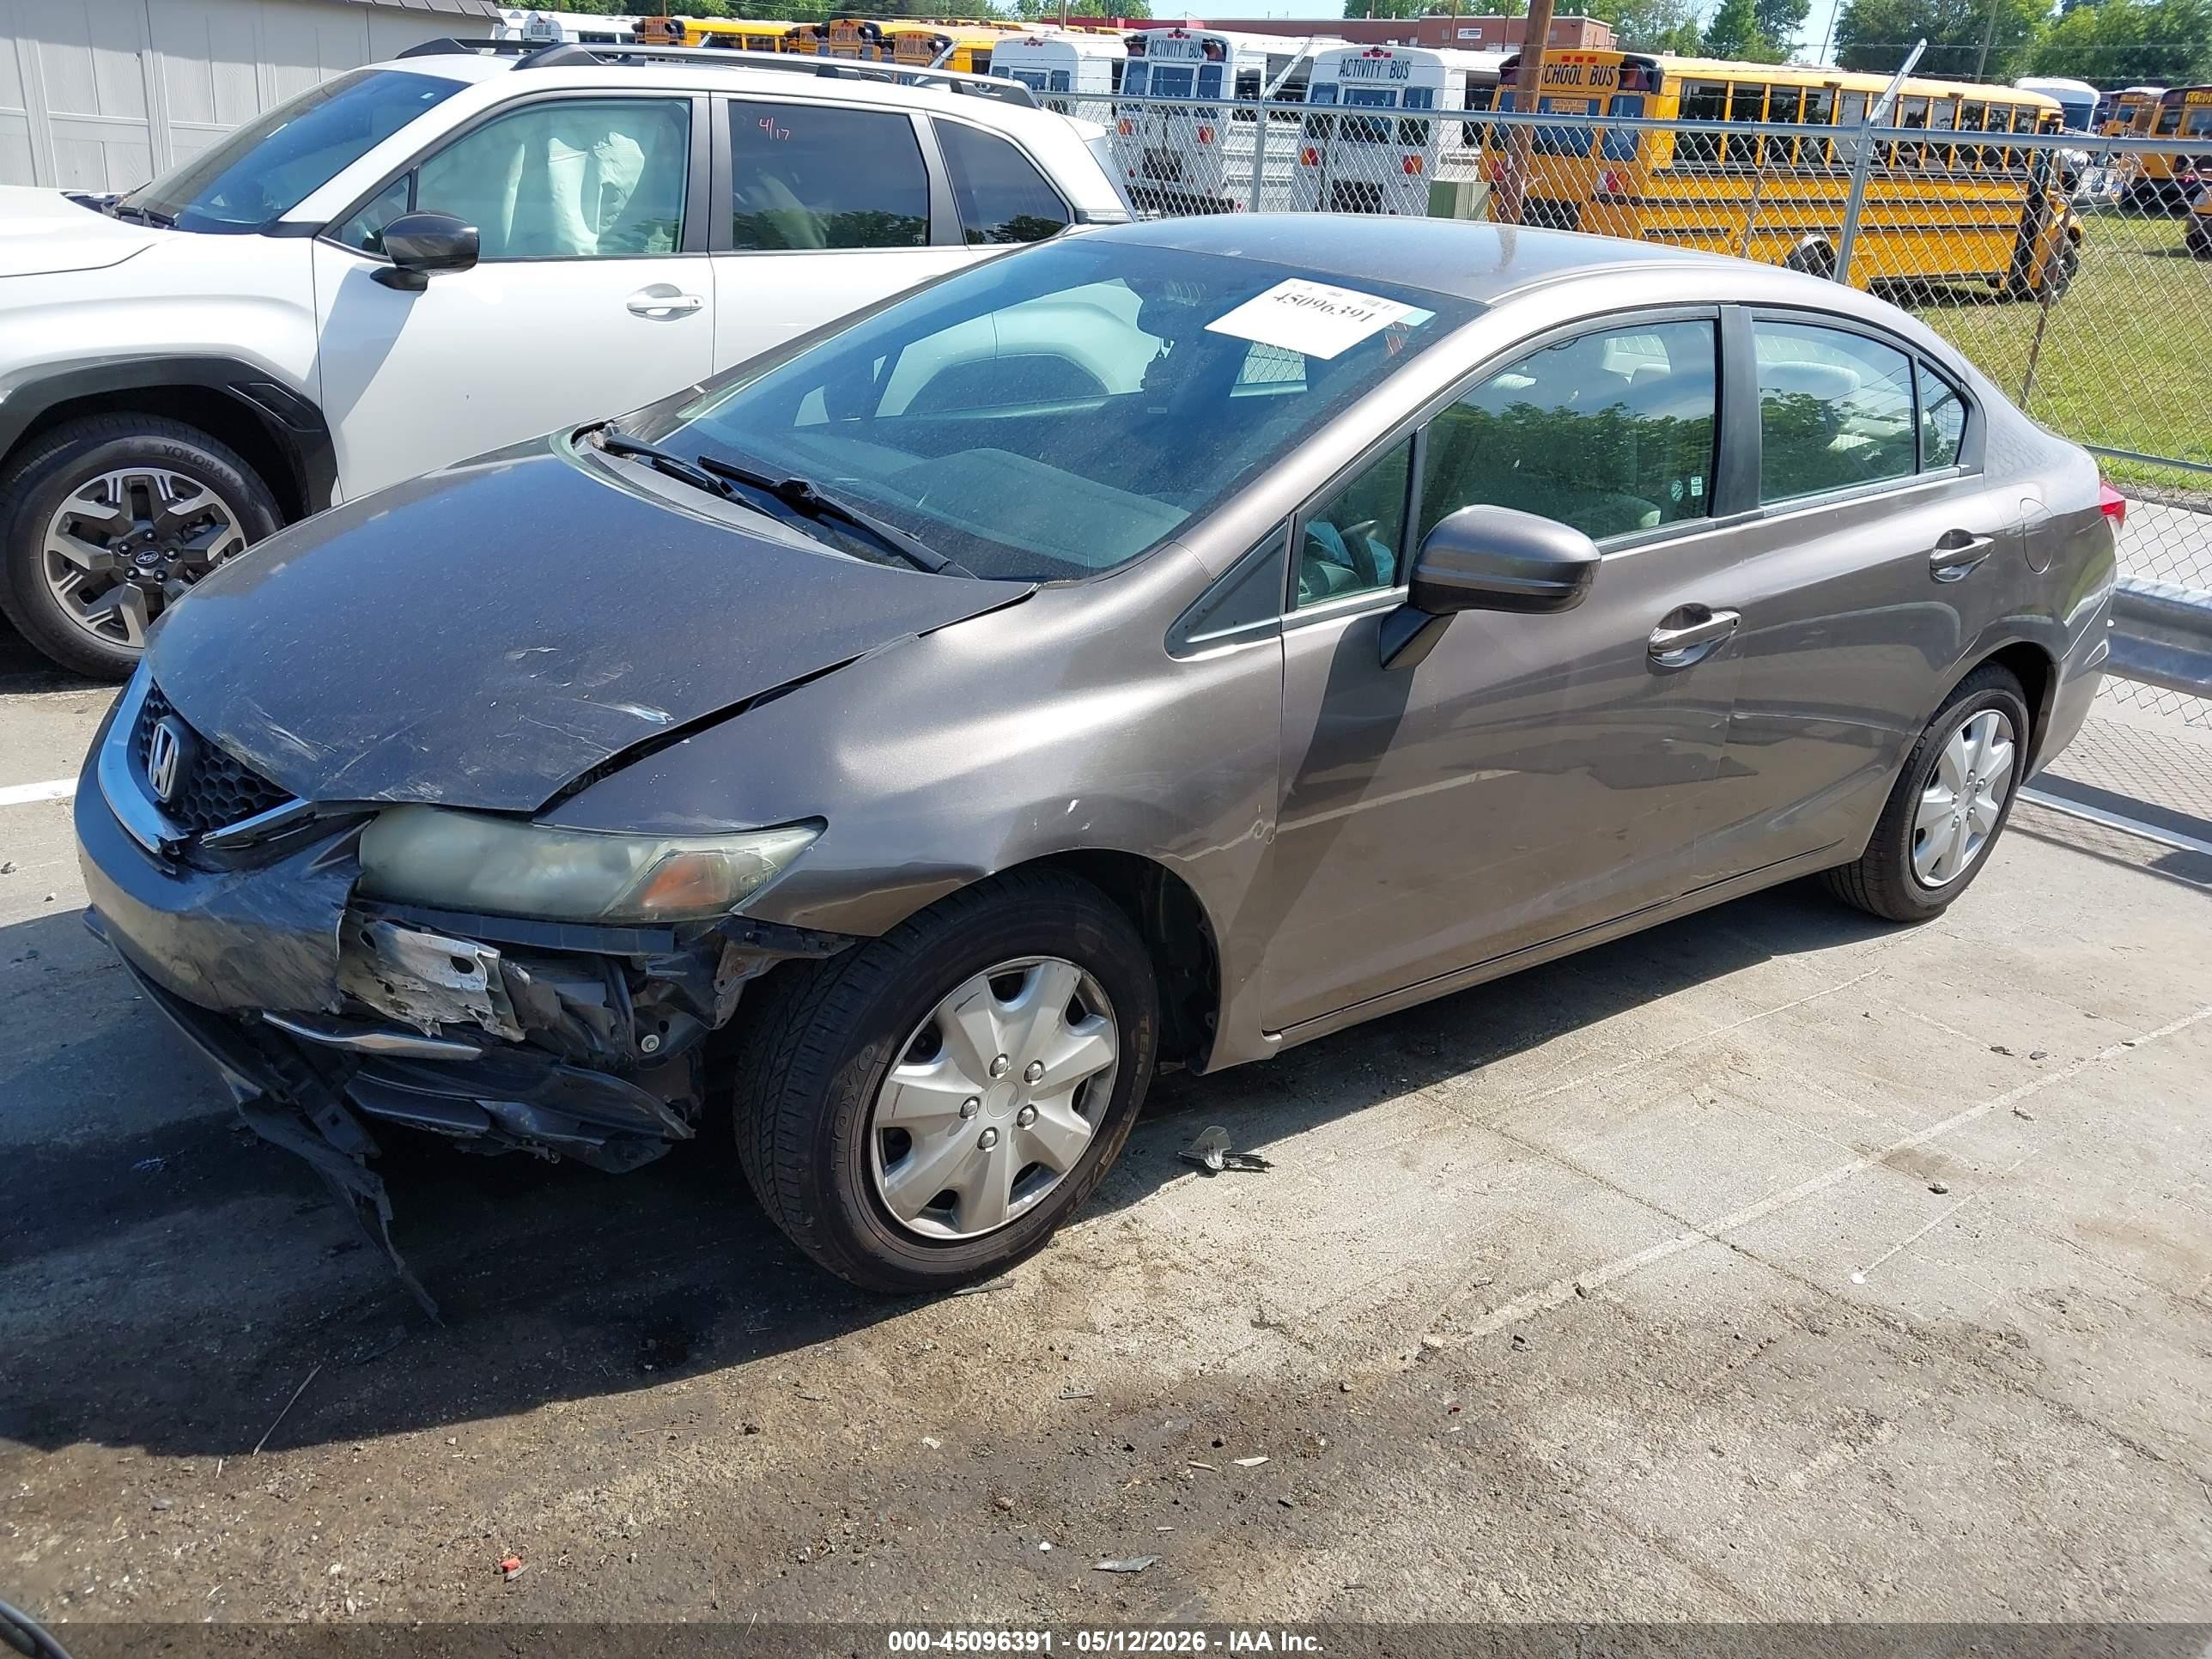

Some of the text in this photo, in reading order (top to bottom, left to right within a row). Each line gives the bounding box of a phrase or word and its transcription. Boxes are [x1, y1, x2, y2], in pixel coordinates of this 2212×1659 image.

[1149, 40, 1184, 58] ACTIVITY
[1339, 58, 1411, 80] ACTIVITY BUS
[1589, 64, 1616, 86] BUS
[759, 117, 790, 141] 4/17
[1273, 291, 1376, 323] 45096391
